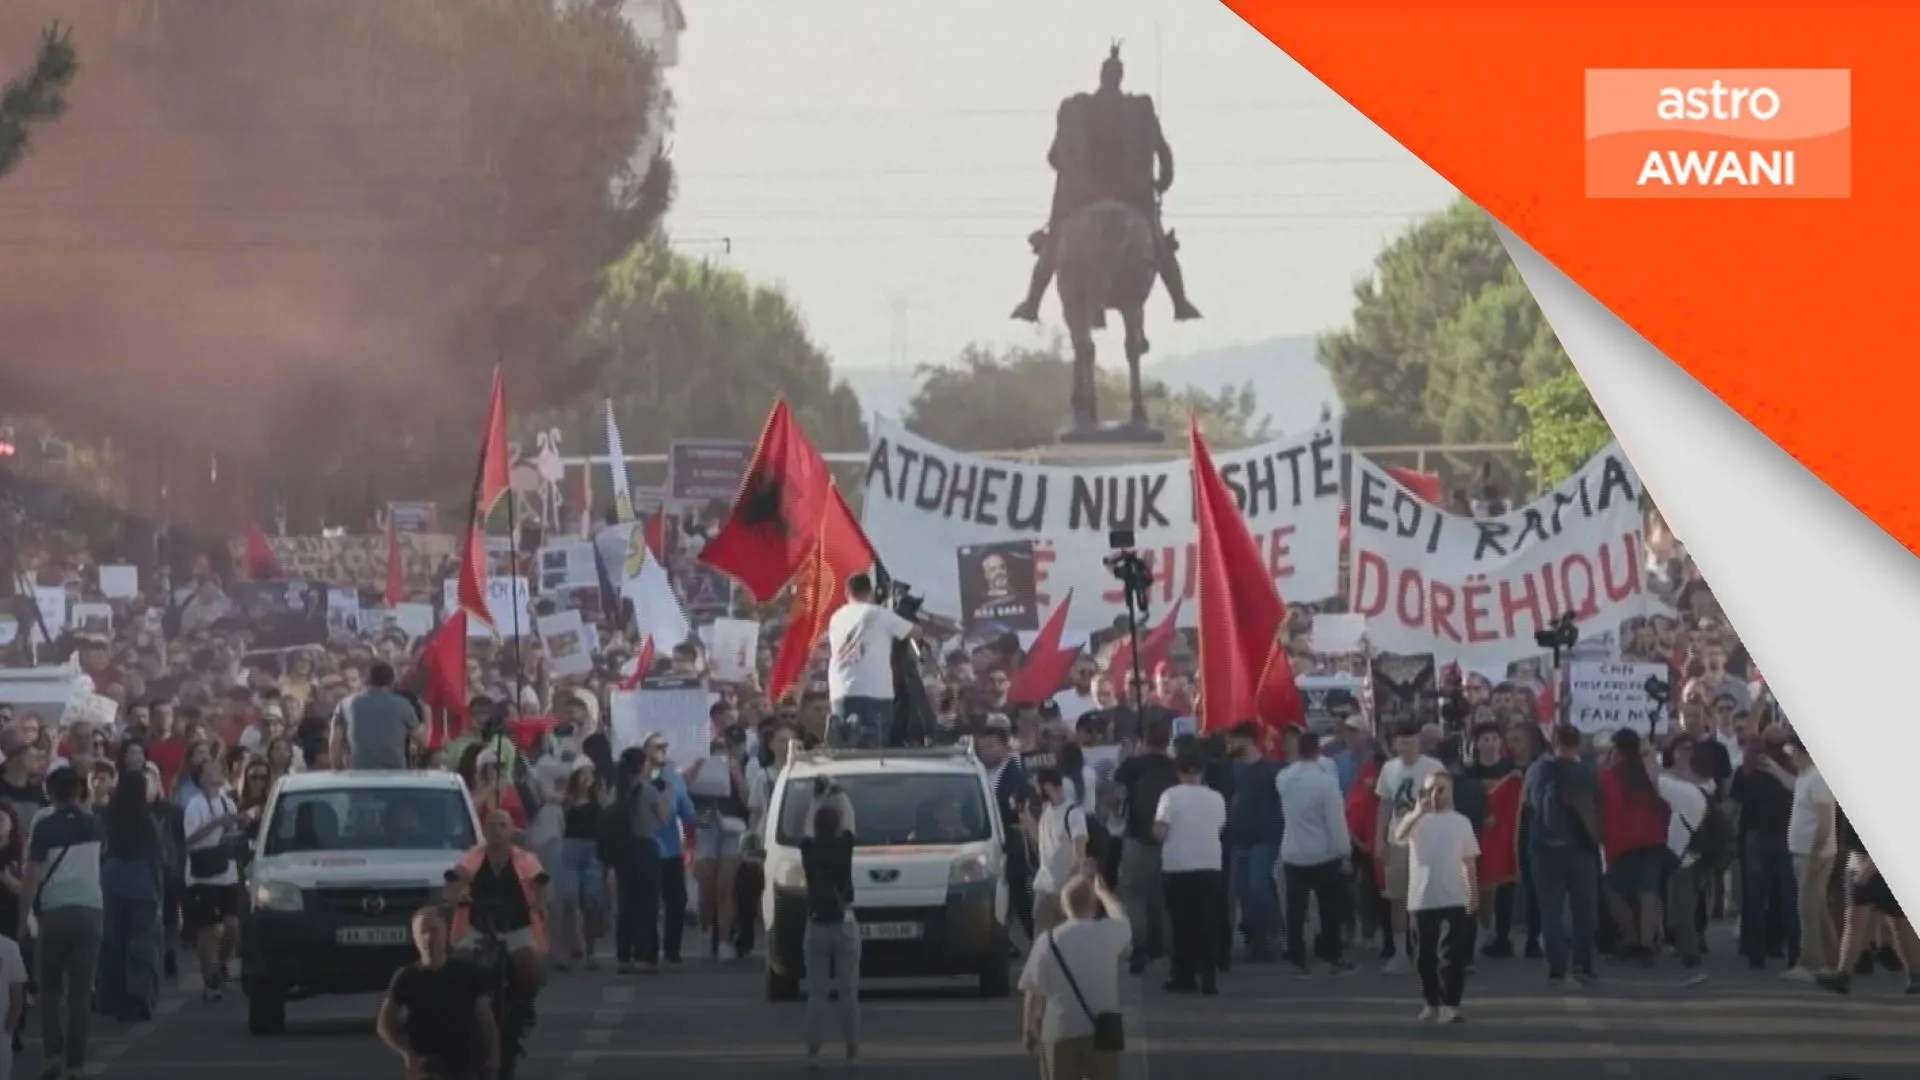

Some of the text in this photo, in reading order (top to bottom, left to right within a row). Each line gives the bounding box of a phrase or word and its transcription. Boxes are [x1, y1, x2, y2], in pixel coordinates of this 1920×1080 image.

[866, 437, 1048, 532] ATDHEU
[1069, 473, 1170, 532] NUK
[1359, 454, 1636, 561] EDI RAMA
